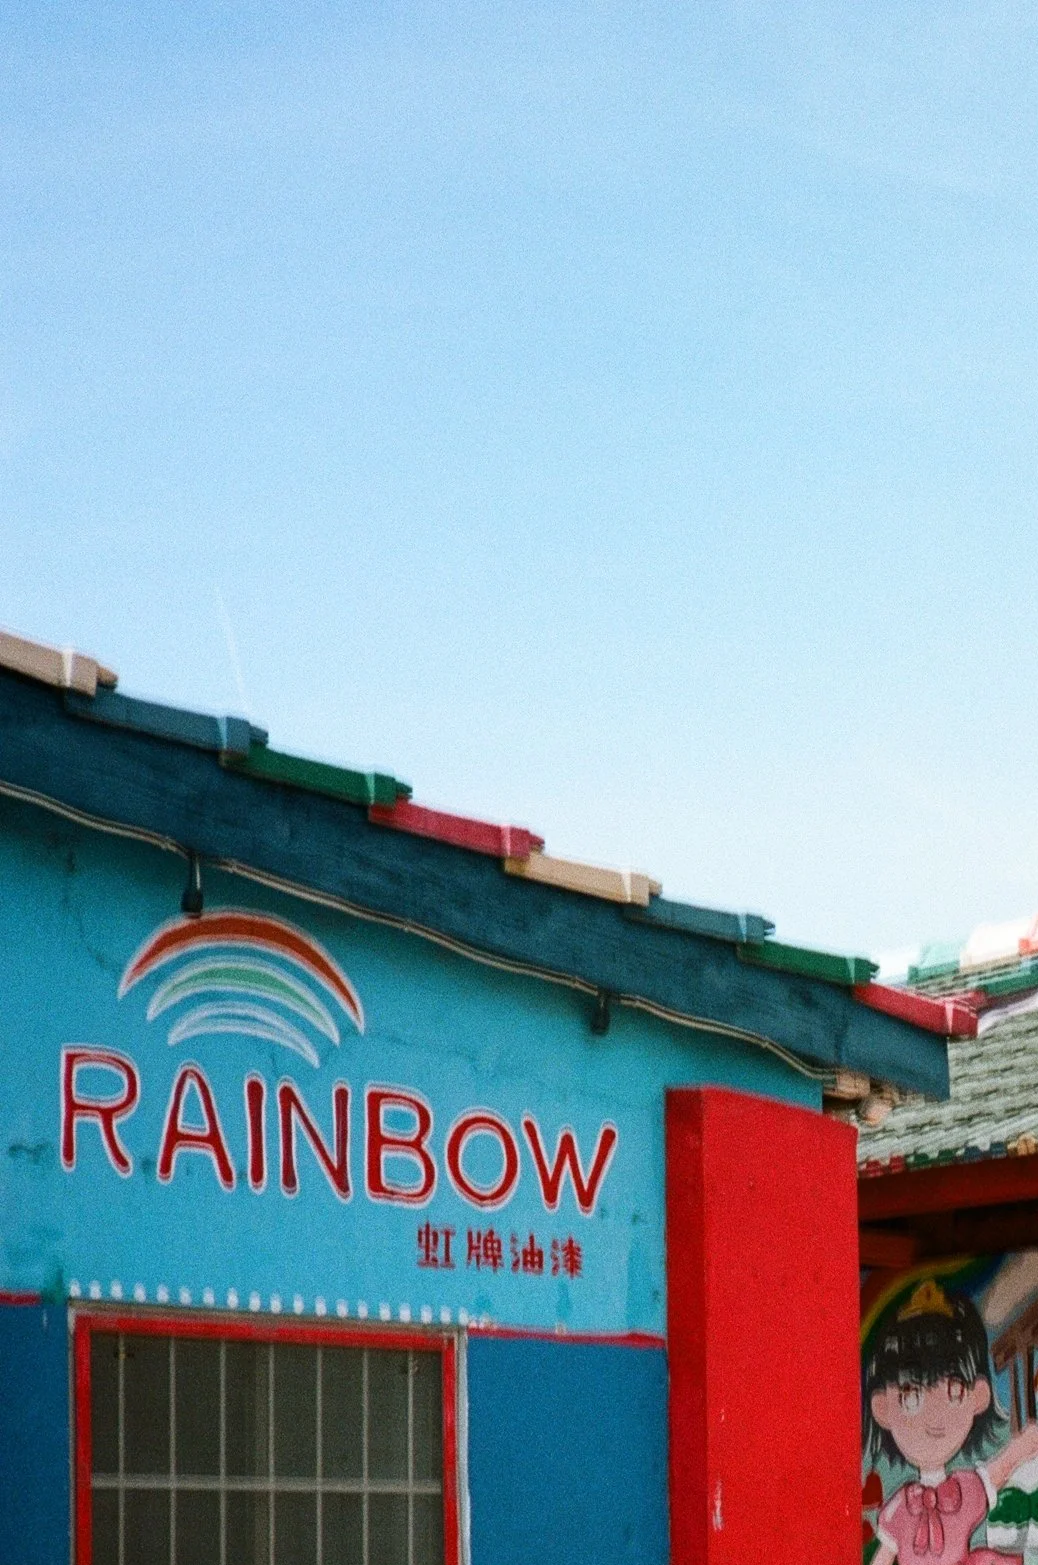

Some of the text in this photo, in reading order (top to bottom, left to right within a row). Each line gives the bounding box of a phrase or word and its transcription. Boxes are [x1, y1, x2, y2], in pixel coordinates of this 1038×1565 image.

[61, 1045, 620, 1217] RAINBOW
[416, 1219, 584, 1280] 虹牌油漆
